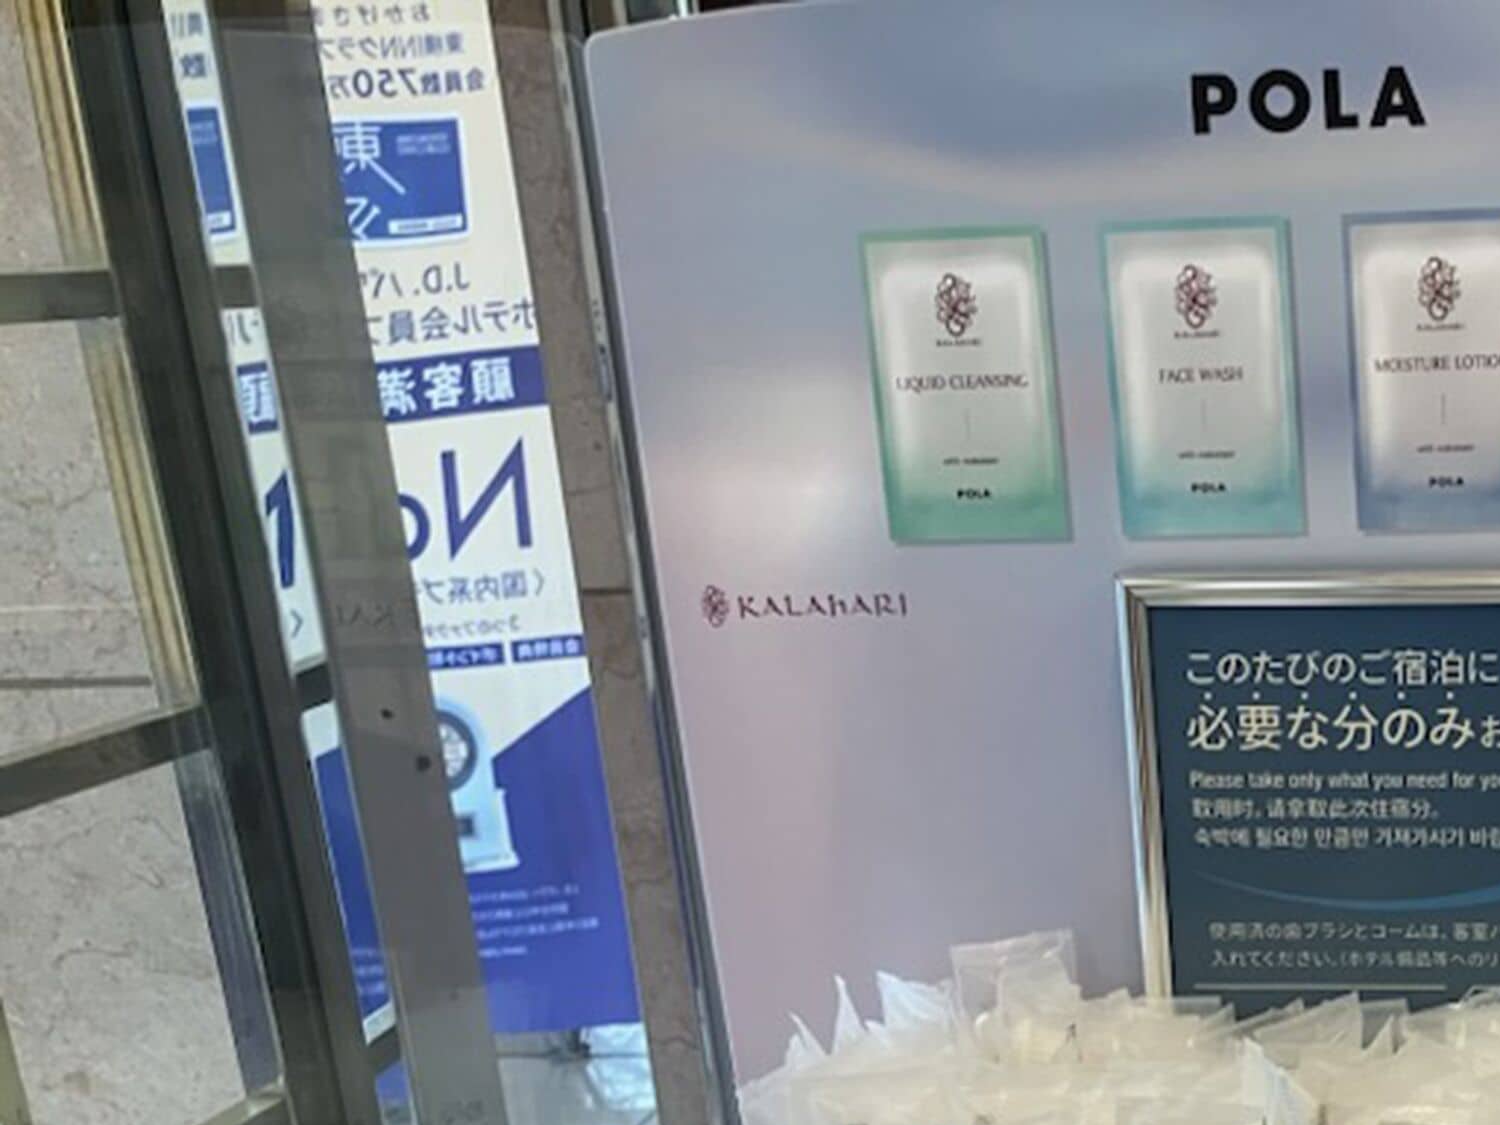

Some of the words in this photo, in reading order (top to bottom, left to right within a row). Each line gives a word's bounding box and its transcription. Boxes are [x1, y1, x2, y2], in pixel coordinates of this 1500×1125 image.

[1191, 65, 1426, 135] POLA
[1158, 367, 1197, 384] FACE
[1200, 365, 1244, 382] WASH
[1374, 353, 1452, 374] MOISTURE
[895, 373, 946, 394] LIQUID
[736, 592, 908, 620] KALAHARI
[1185, 650, 1500, 687] このたびのご宿泊に
[1190, 771, 1244, 790] Please
[1249, 771, 1284, 790] take
[1288, 772, 1323, 794] only
[1328, 772, 1369, 790] what
[1372, 776, 1403, 795] you
[1407, 772, 1447, 790] need
[1452, 771, 1476, 790] for
